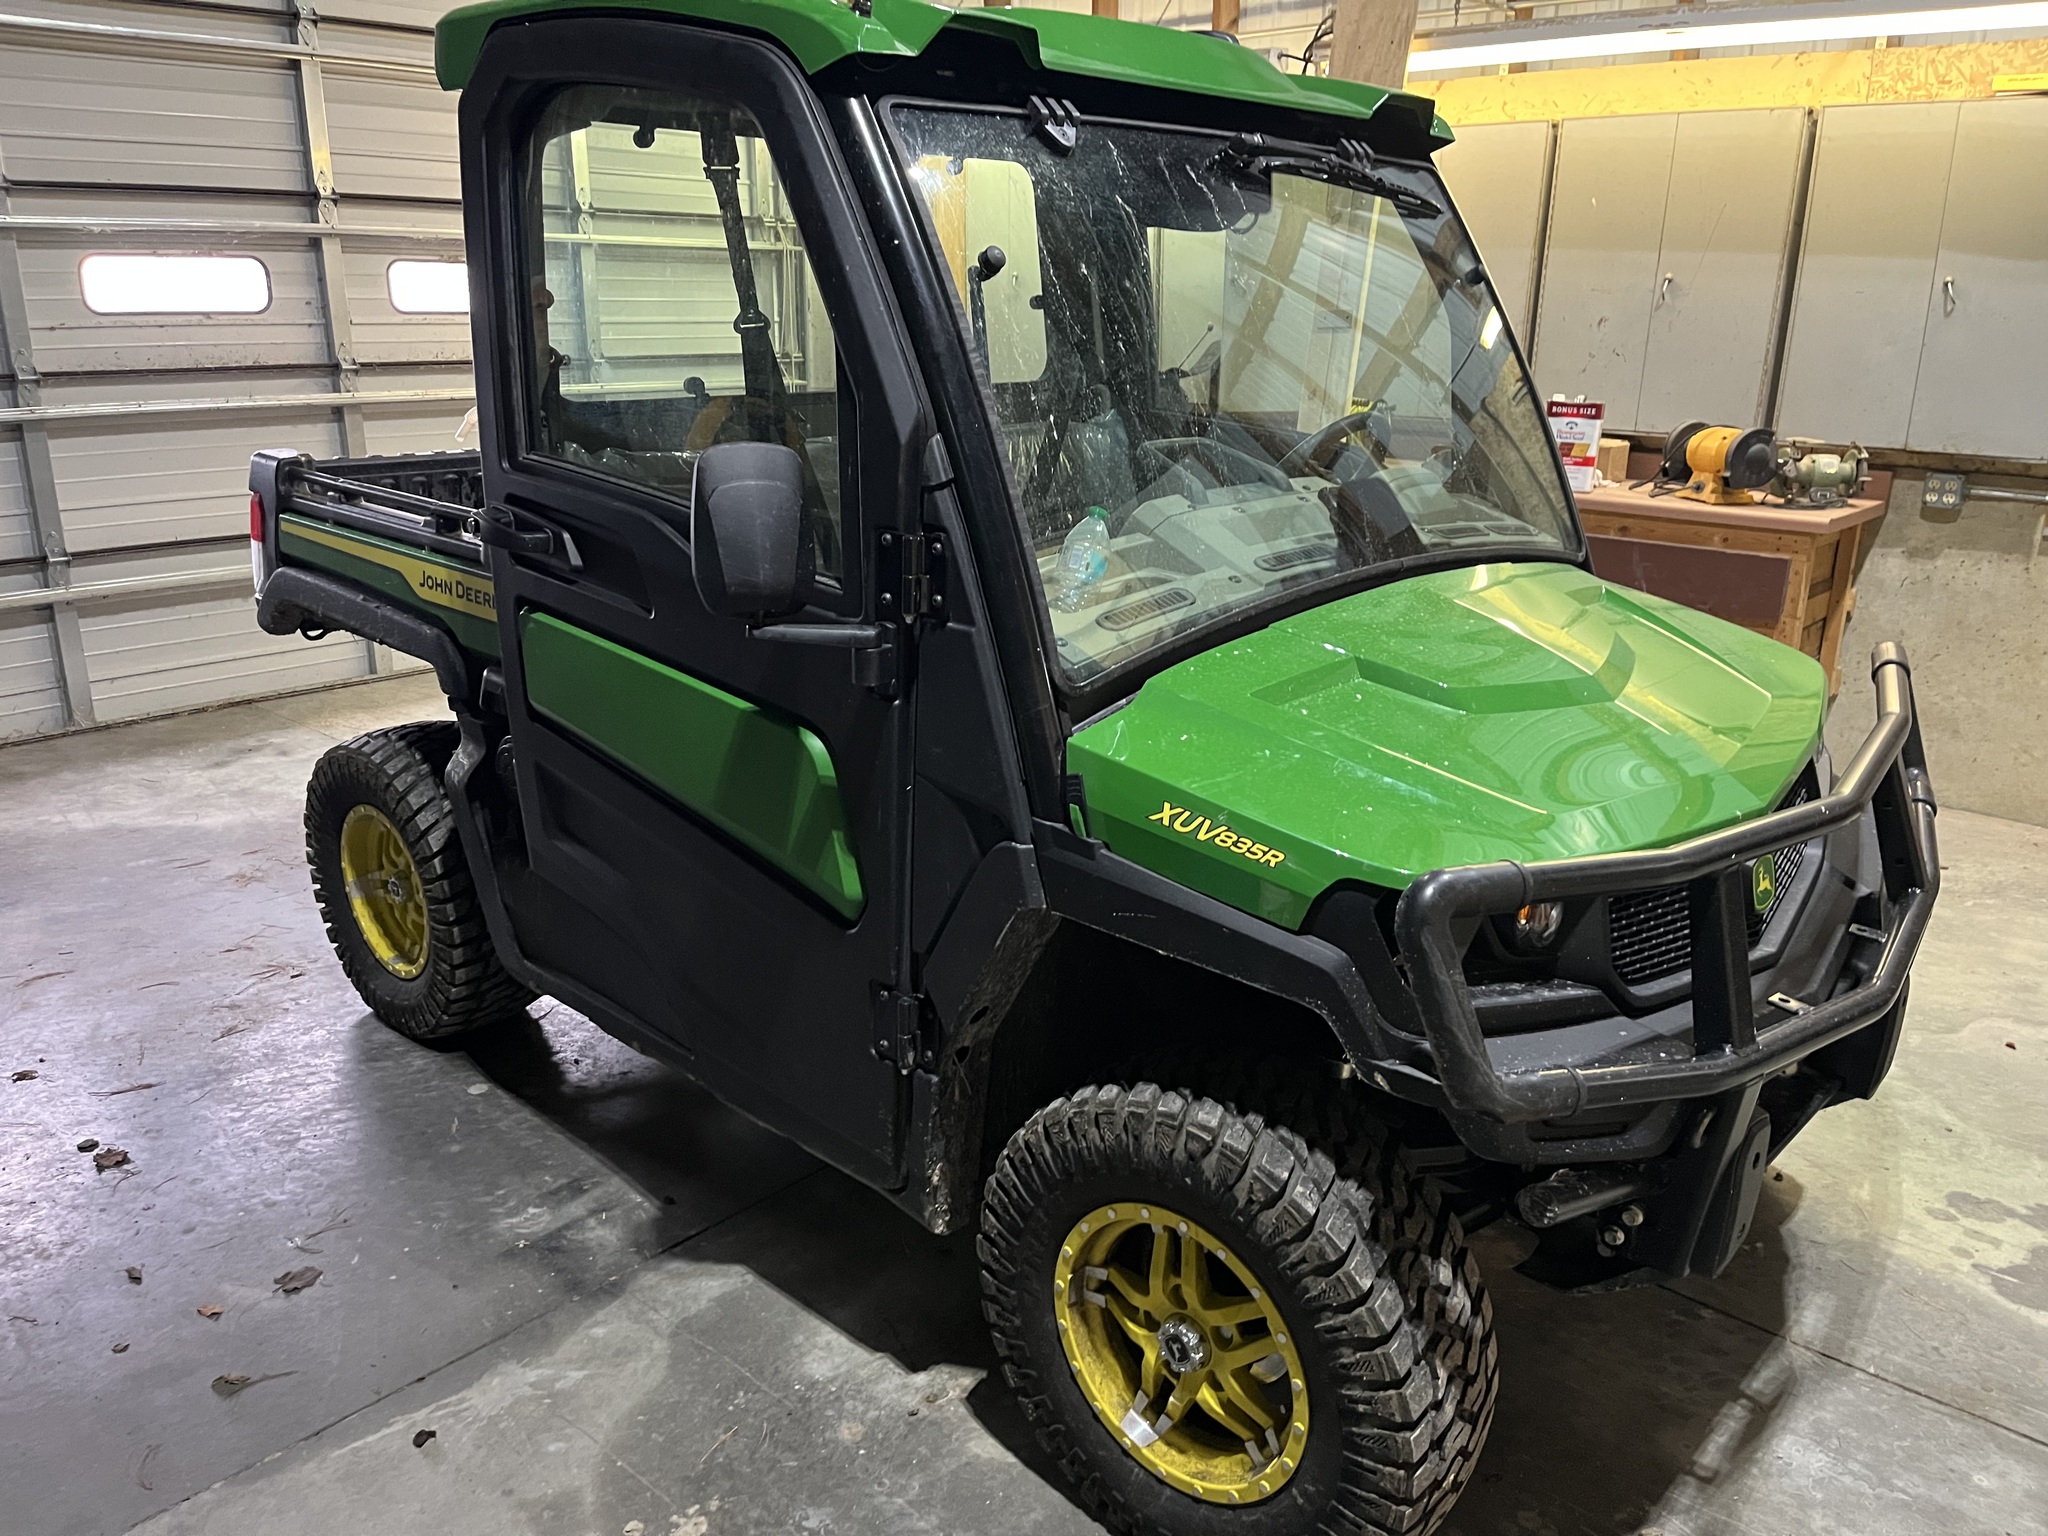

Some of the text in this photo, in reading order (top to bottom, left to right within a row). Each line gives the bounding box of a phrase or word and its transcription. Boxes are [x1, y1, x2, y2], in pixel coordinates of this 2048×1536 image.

[1551, 405, 1597, 415] BONUS SIZE
[419, 570, 453, 597] JOHN
[1147, 800, 1286, 869] XUV835R
